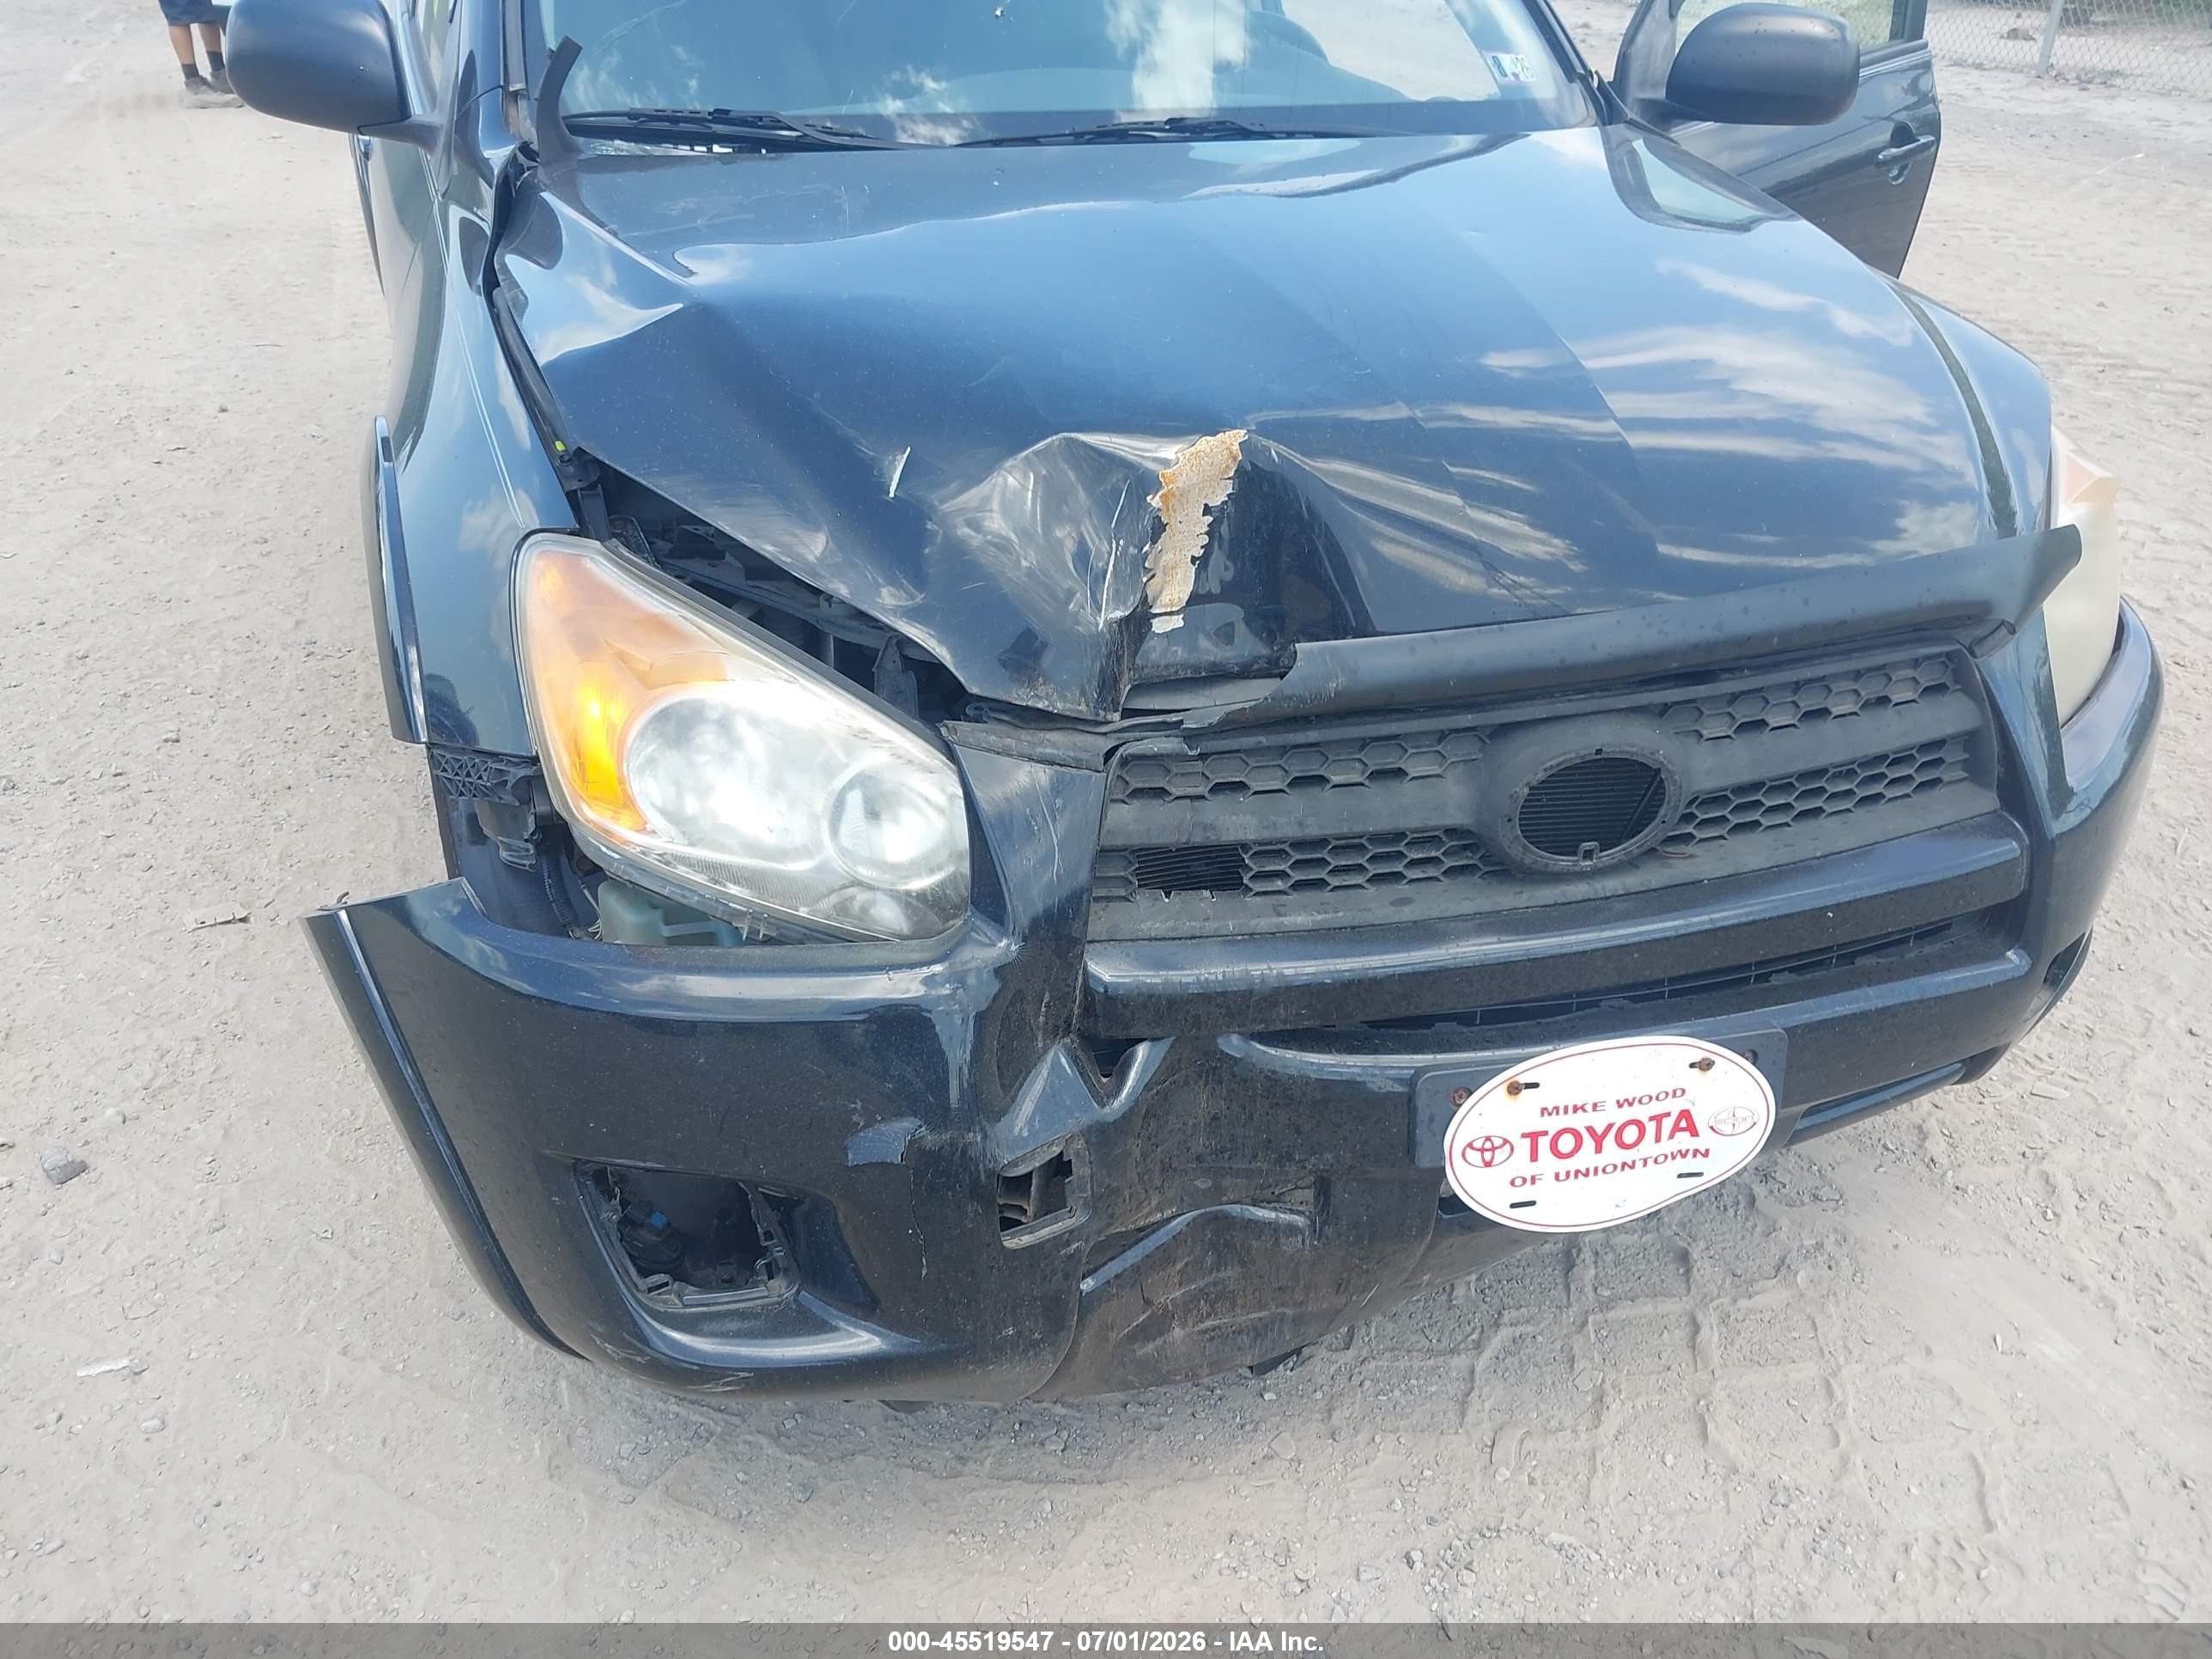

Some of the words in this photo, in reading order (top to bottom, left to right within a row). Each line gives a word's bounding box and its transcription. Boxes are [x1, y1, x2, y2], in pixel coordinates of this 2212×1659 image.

[1540, 1100, 1606, 1117] MIKE
[1615, 1087, 1686, 1110] WOOD
[1520, 1109, 1699, 1164] TOYOTA
[1510, 1173, 1543, 1188] OF
[1553, 1147, 1711, 1183] UNIONTOWN
